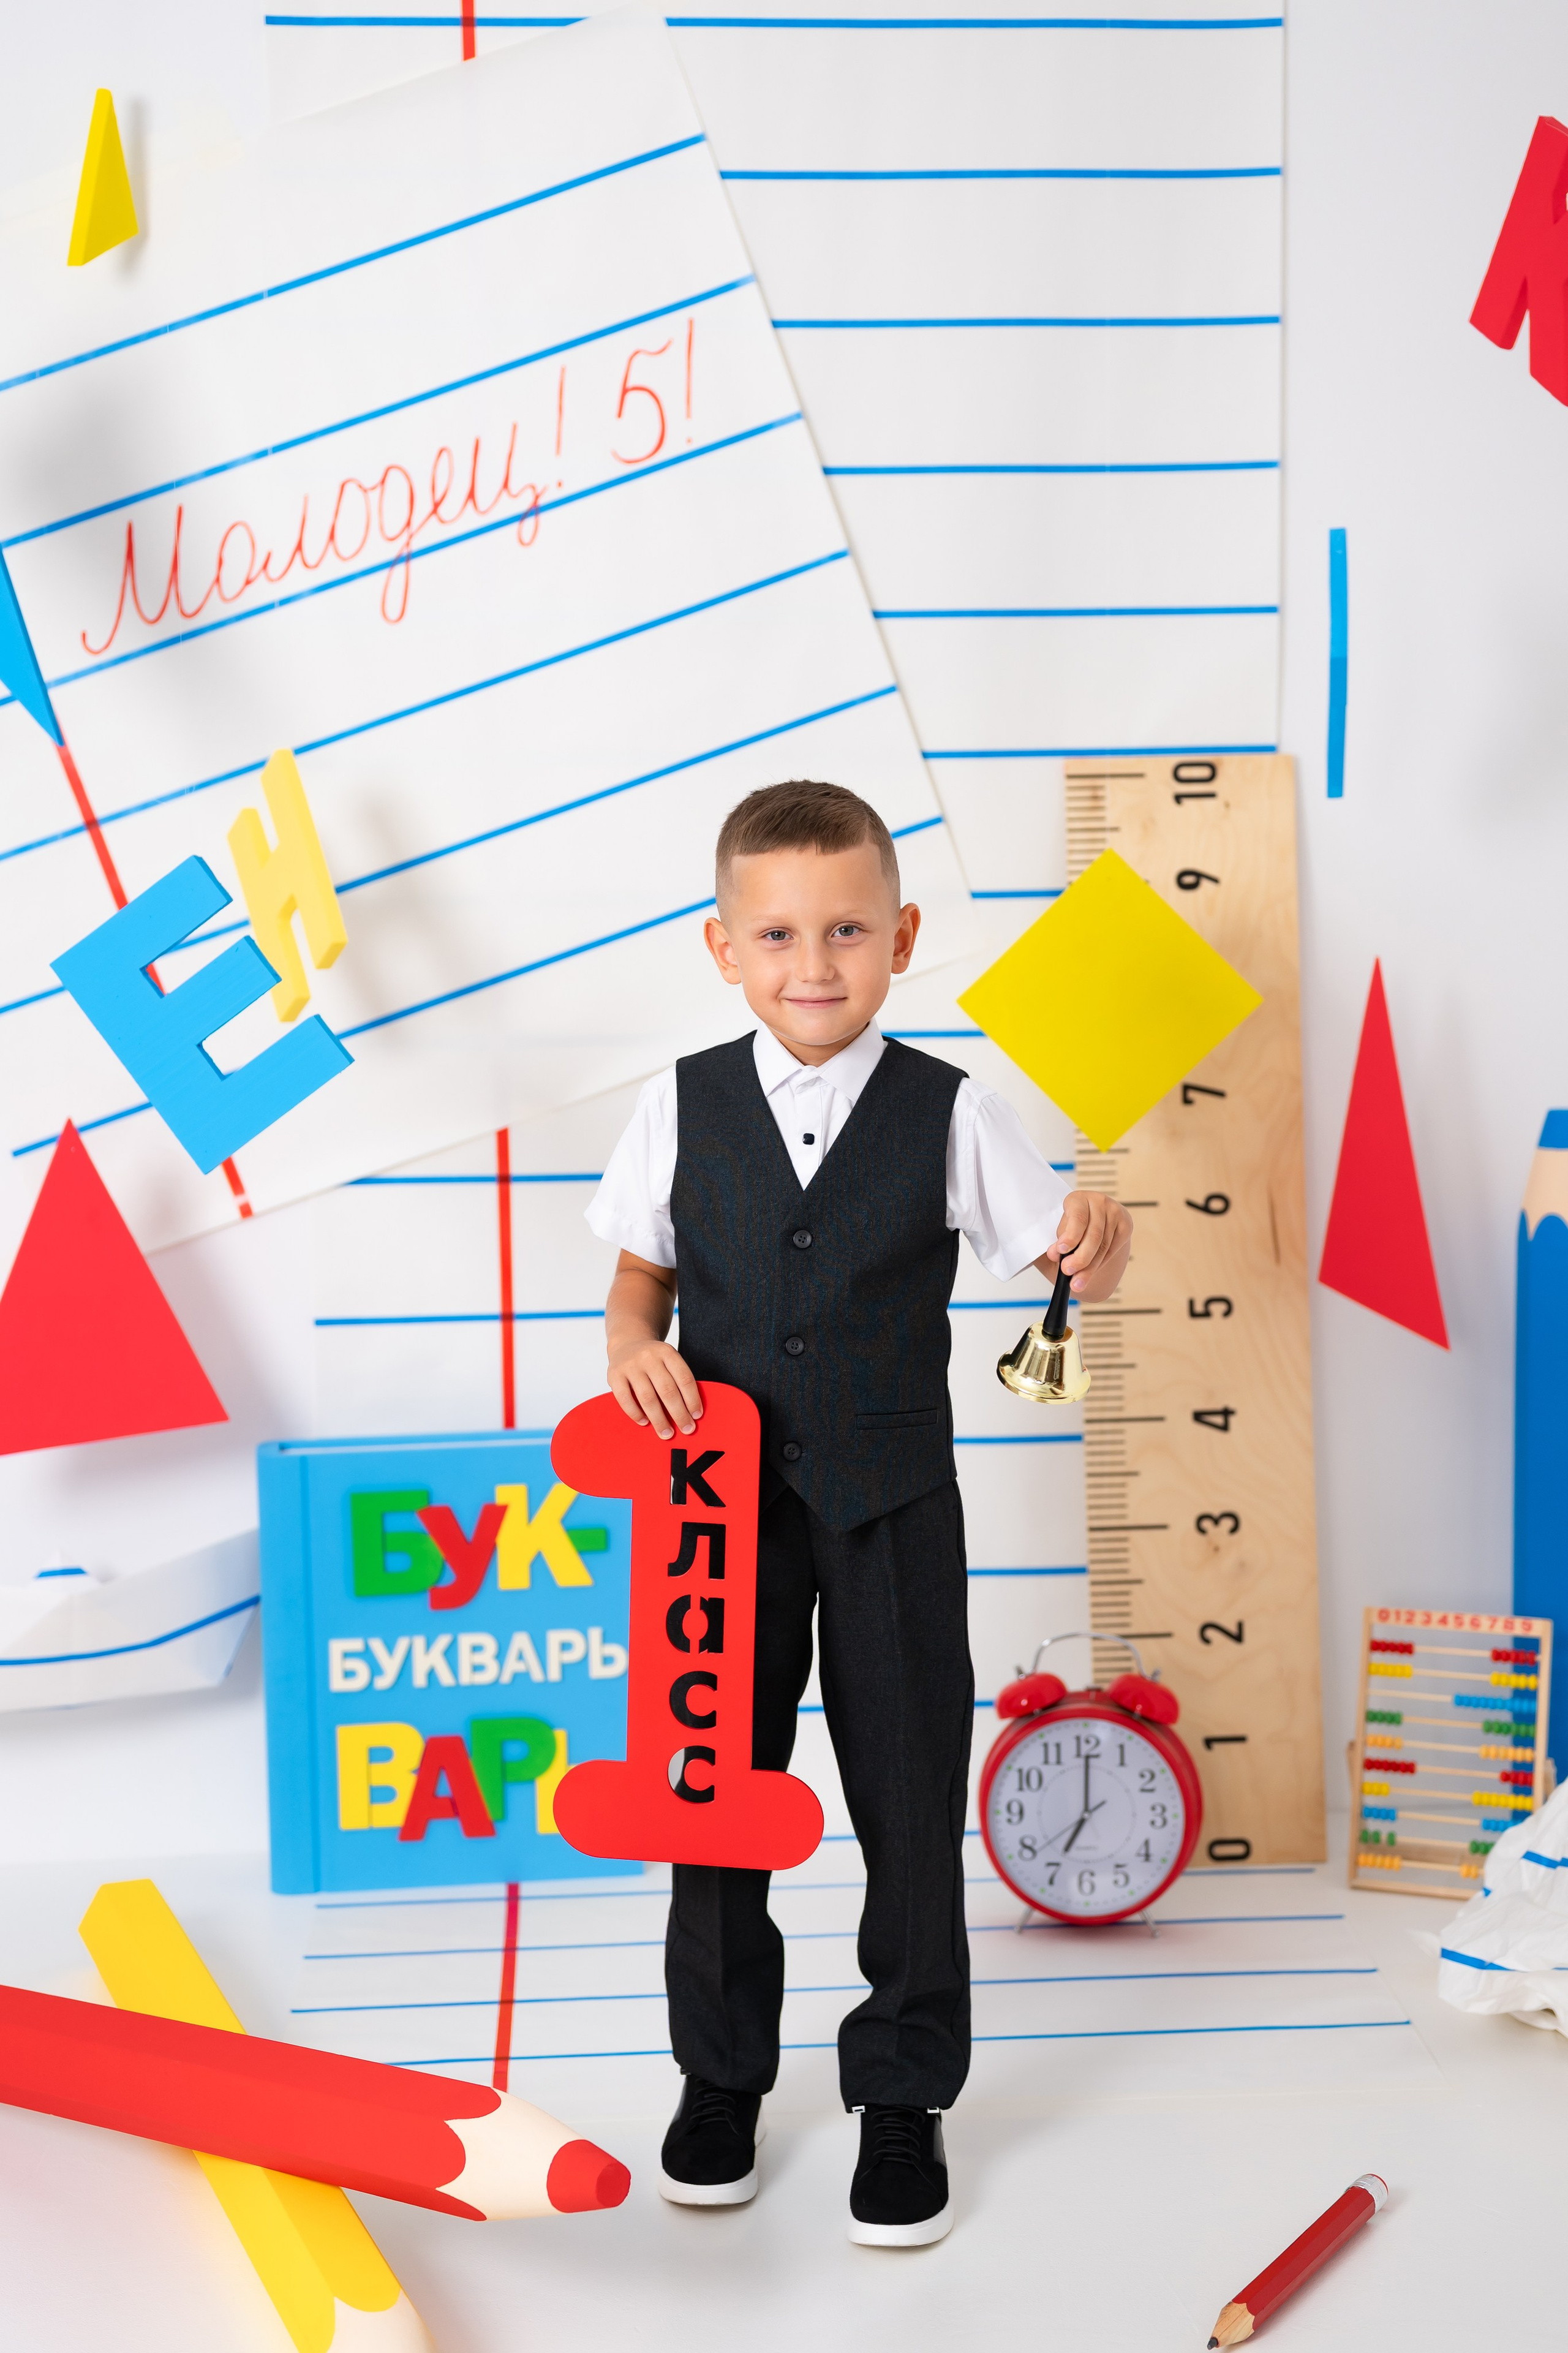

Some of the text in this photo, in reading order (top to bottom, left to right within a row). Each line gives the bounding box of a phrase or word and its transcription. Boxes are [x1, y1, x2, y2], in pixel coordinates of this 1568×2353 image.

[81, 317, 695, 654] Молодец! 5!
[1172, 761, 1218, 805] 10
[1176, 868, 1220, 891] 9
[49, 855, 355, 1175] Е
[1182, 1082, 1227, 1105] 7
[1186, 1193, 1231, 1215] 6
[1189, 1295, 1234, 1319] 5
[1193, 1406, 1236, 1432] 4
[1196, 1510, 1242, 1535] 3
[1200, 1620, 1245, 1645] 2
[1378, 1608, 1533, 1633] 0 1 2 3 4 5 6 7 8 9
[328, 1628, 628, 1693] БУКВАРЬ
[1042, 1742, 1063, 1765] 11
[1075, 1734, 1101, 1759] 12
[1117, 1743, 1126, 1767] 1
[1204, 1735, 1248, 1751] 1
[1017, 1767, 1042, 1792] 10
[1139, 1769, 1156, 1792] 2
[1006, 1799, 1024, 1825] 9
[1150, 1803, 1168, 1829] 3
[1019, 1835, 1037, 1860] 8
[1136, 1838, 1152, 1863] 4
[1208, 1838, 1251, 1862] 0
[1046, 1862, 1061, 1886] 7
[1077, 1870, 1096, 1896] 6
[1113, 1864, 1129, 1888] 5
